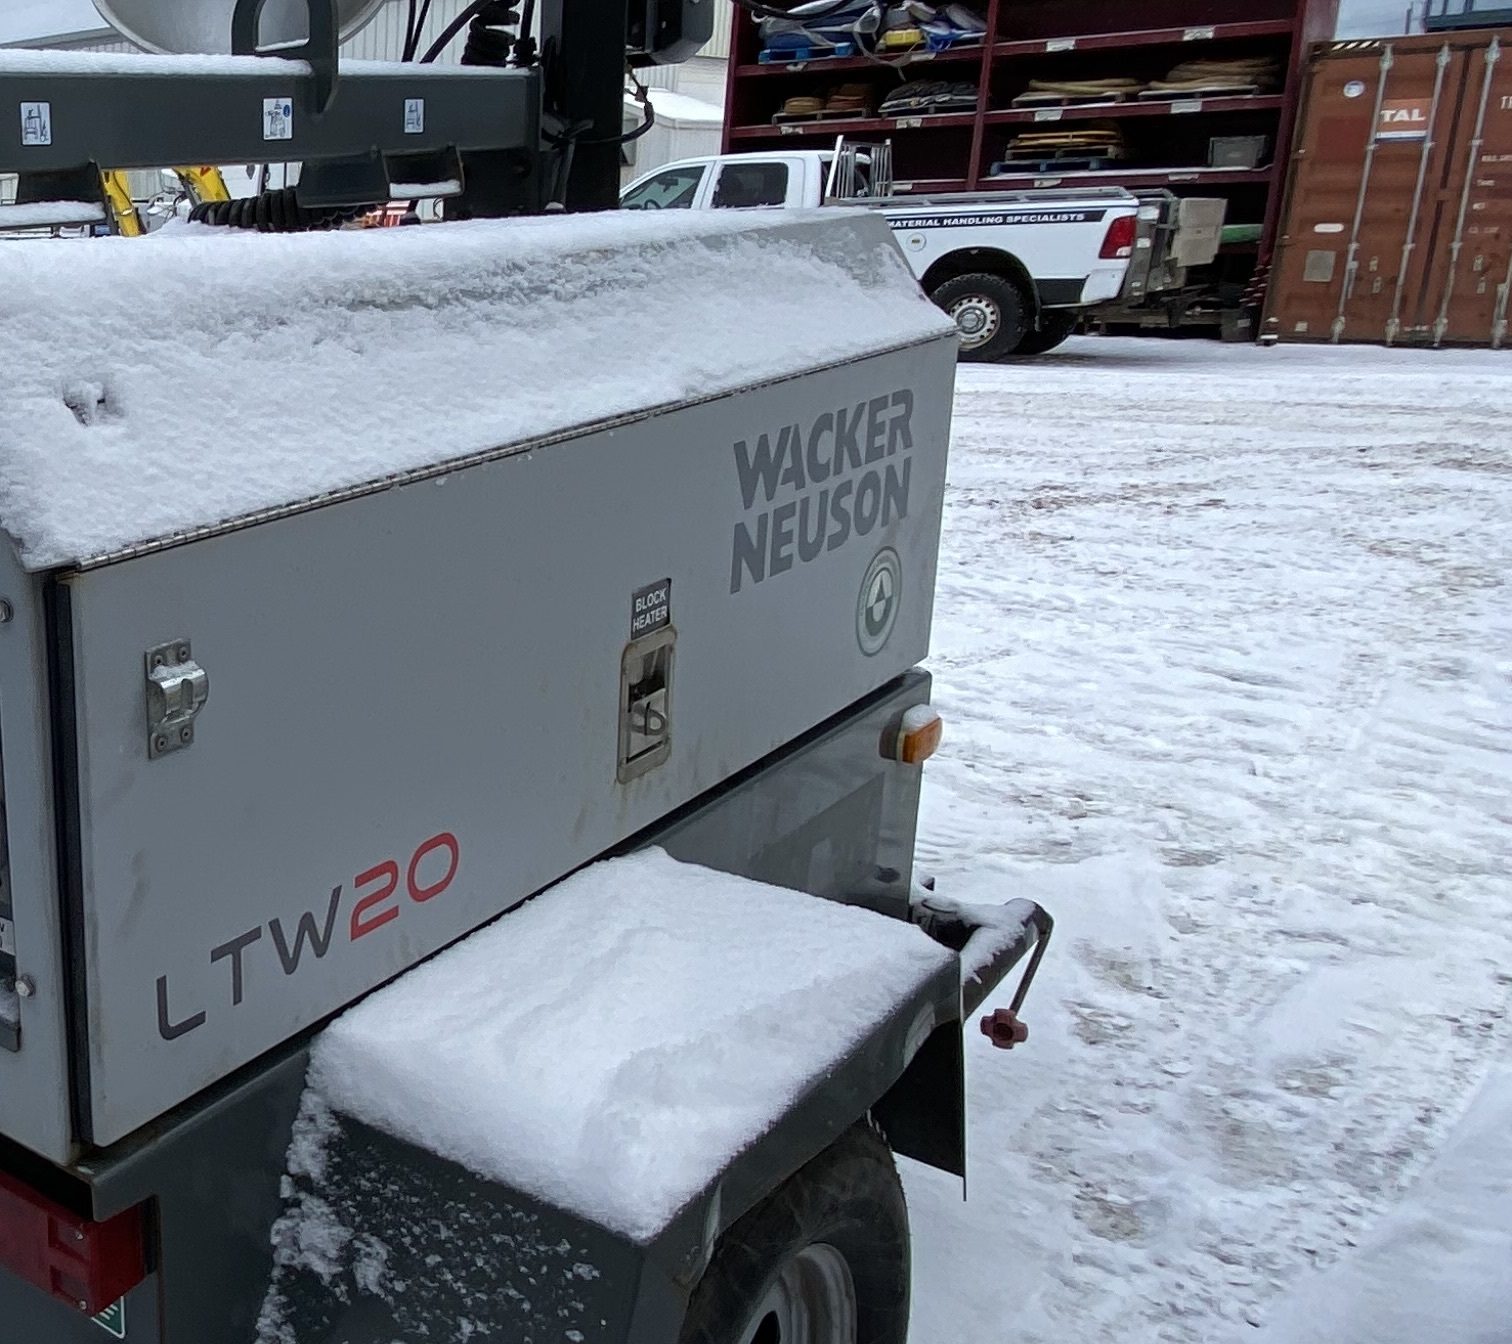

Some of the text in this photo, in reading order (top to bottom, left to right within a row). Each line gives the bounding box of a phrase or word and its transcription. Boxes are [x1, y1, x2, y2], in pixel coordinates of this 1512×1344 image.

[1380, 109, 1426, 122] TAL
[888, 213, 1085, 228] MATERIAL HANDLING SPECIALISTS
[733, 389, 914, 510] WACKER
[730, 457, 912, 594] NEUSON
[635, 587, 667, 613] BLOCK
[632, 605, 667, 633] HEATER
[156, 832, 459, 1040] LTW20
